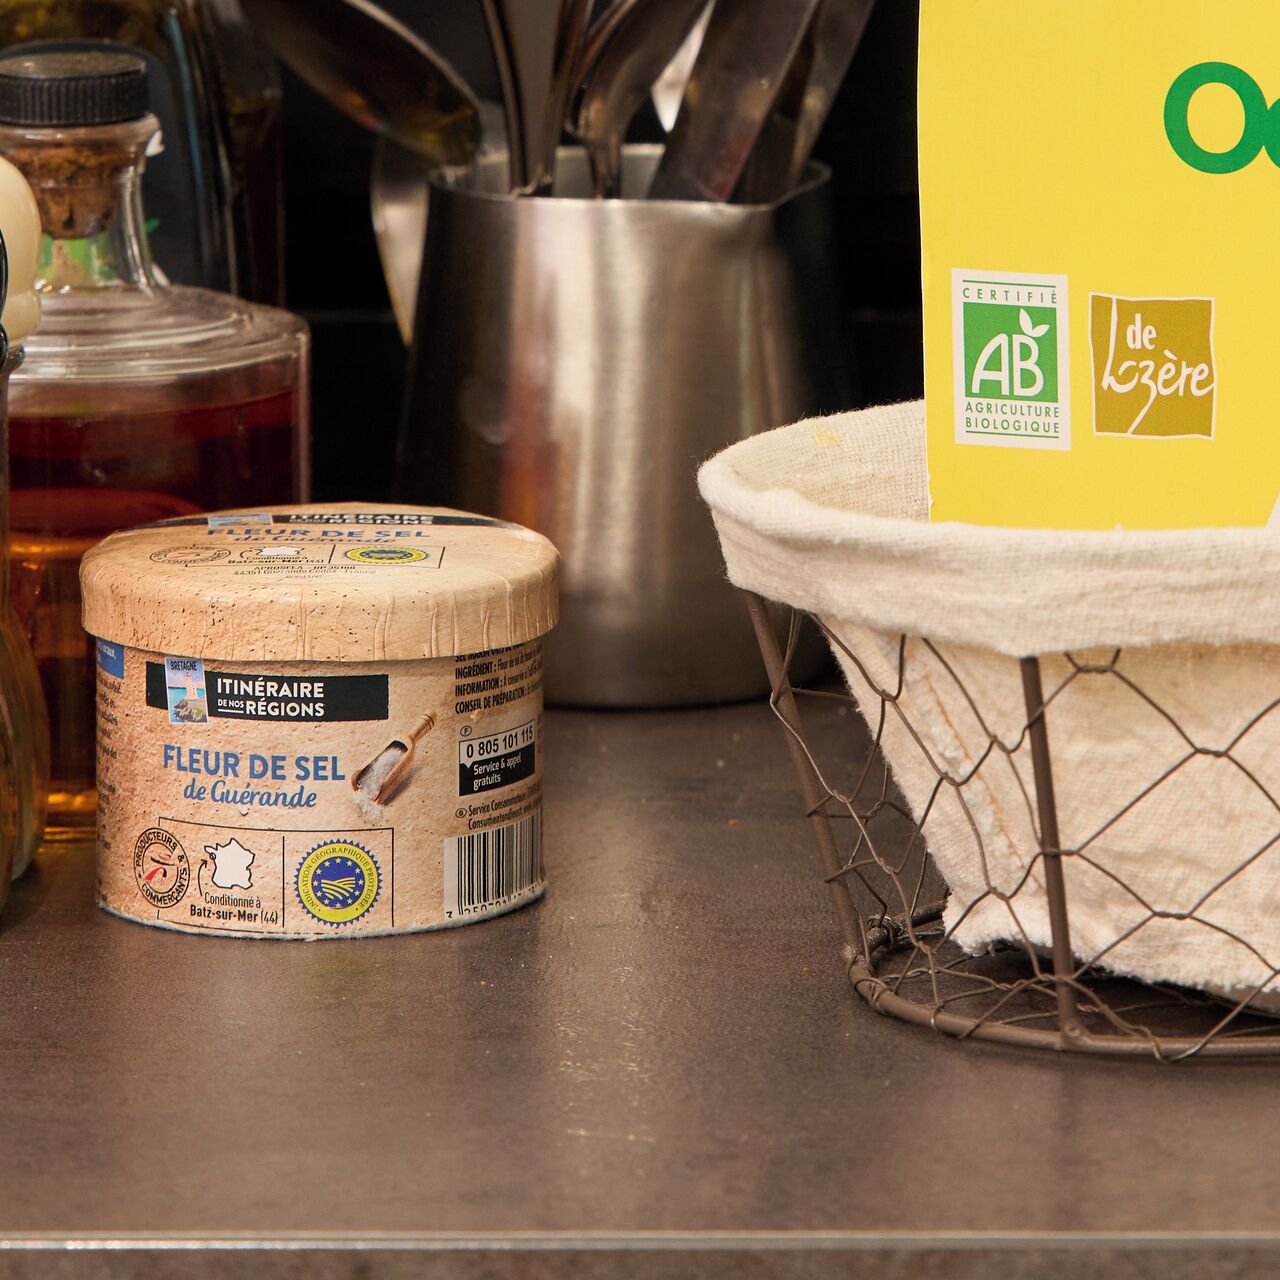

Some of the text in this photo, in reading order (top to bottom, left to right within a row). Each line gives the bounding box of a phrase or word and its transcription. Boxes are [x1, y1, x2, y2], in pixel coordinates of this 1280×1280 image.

[962, 287, 1057, 304] CERTIFIÉ
[1126, 313, 1157, 350] de
[971, 333, 1044, 397] AB
[965, 401, 1060, 418] AGRICULTURE
[965, 417, 1060, 434] BIOLOGIQUE
[321, 530, 364, 538] DE
[170, 660, 197, 672] BRETAGNE
[455, 662, 493, 680] INGRÉDIENT
[217, 676, 325, 698] ITINÉRAIRE
[455, 678, 500, 697] INFORMATION
[218, 698, 325, 717] DE NOS RÉGIONS
[455, 698, 482, 714] CONSEIL
[483, 696, 492, 710] DE
[466, 725, 534, 758] 0 805 101 115
[163, 744, 346, 781] FLEUR DE SEL
[473, 761, 500, 776] Service
[473, 773, 501, 791] gratuits
[183, 778, 318, 808] de Guérande
[468, 803, 490, 818] Service
[136, 831, 177, 868] PRODUCTEURS
[141, 867, 188, 905] COMMERÇANTS
[302, 864, 319, 910] INDICATION
[204, 892, 261, 909] Conditionné à
[190, 904, 279, 925] Batz-sur-Mer (44)
